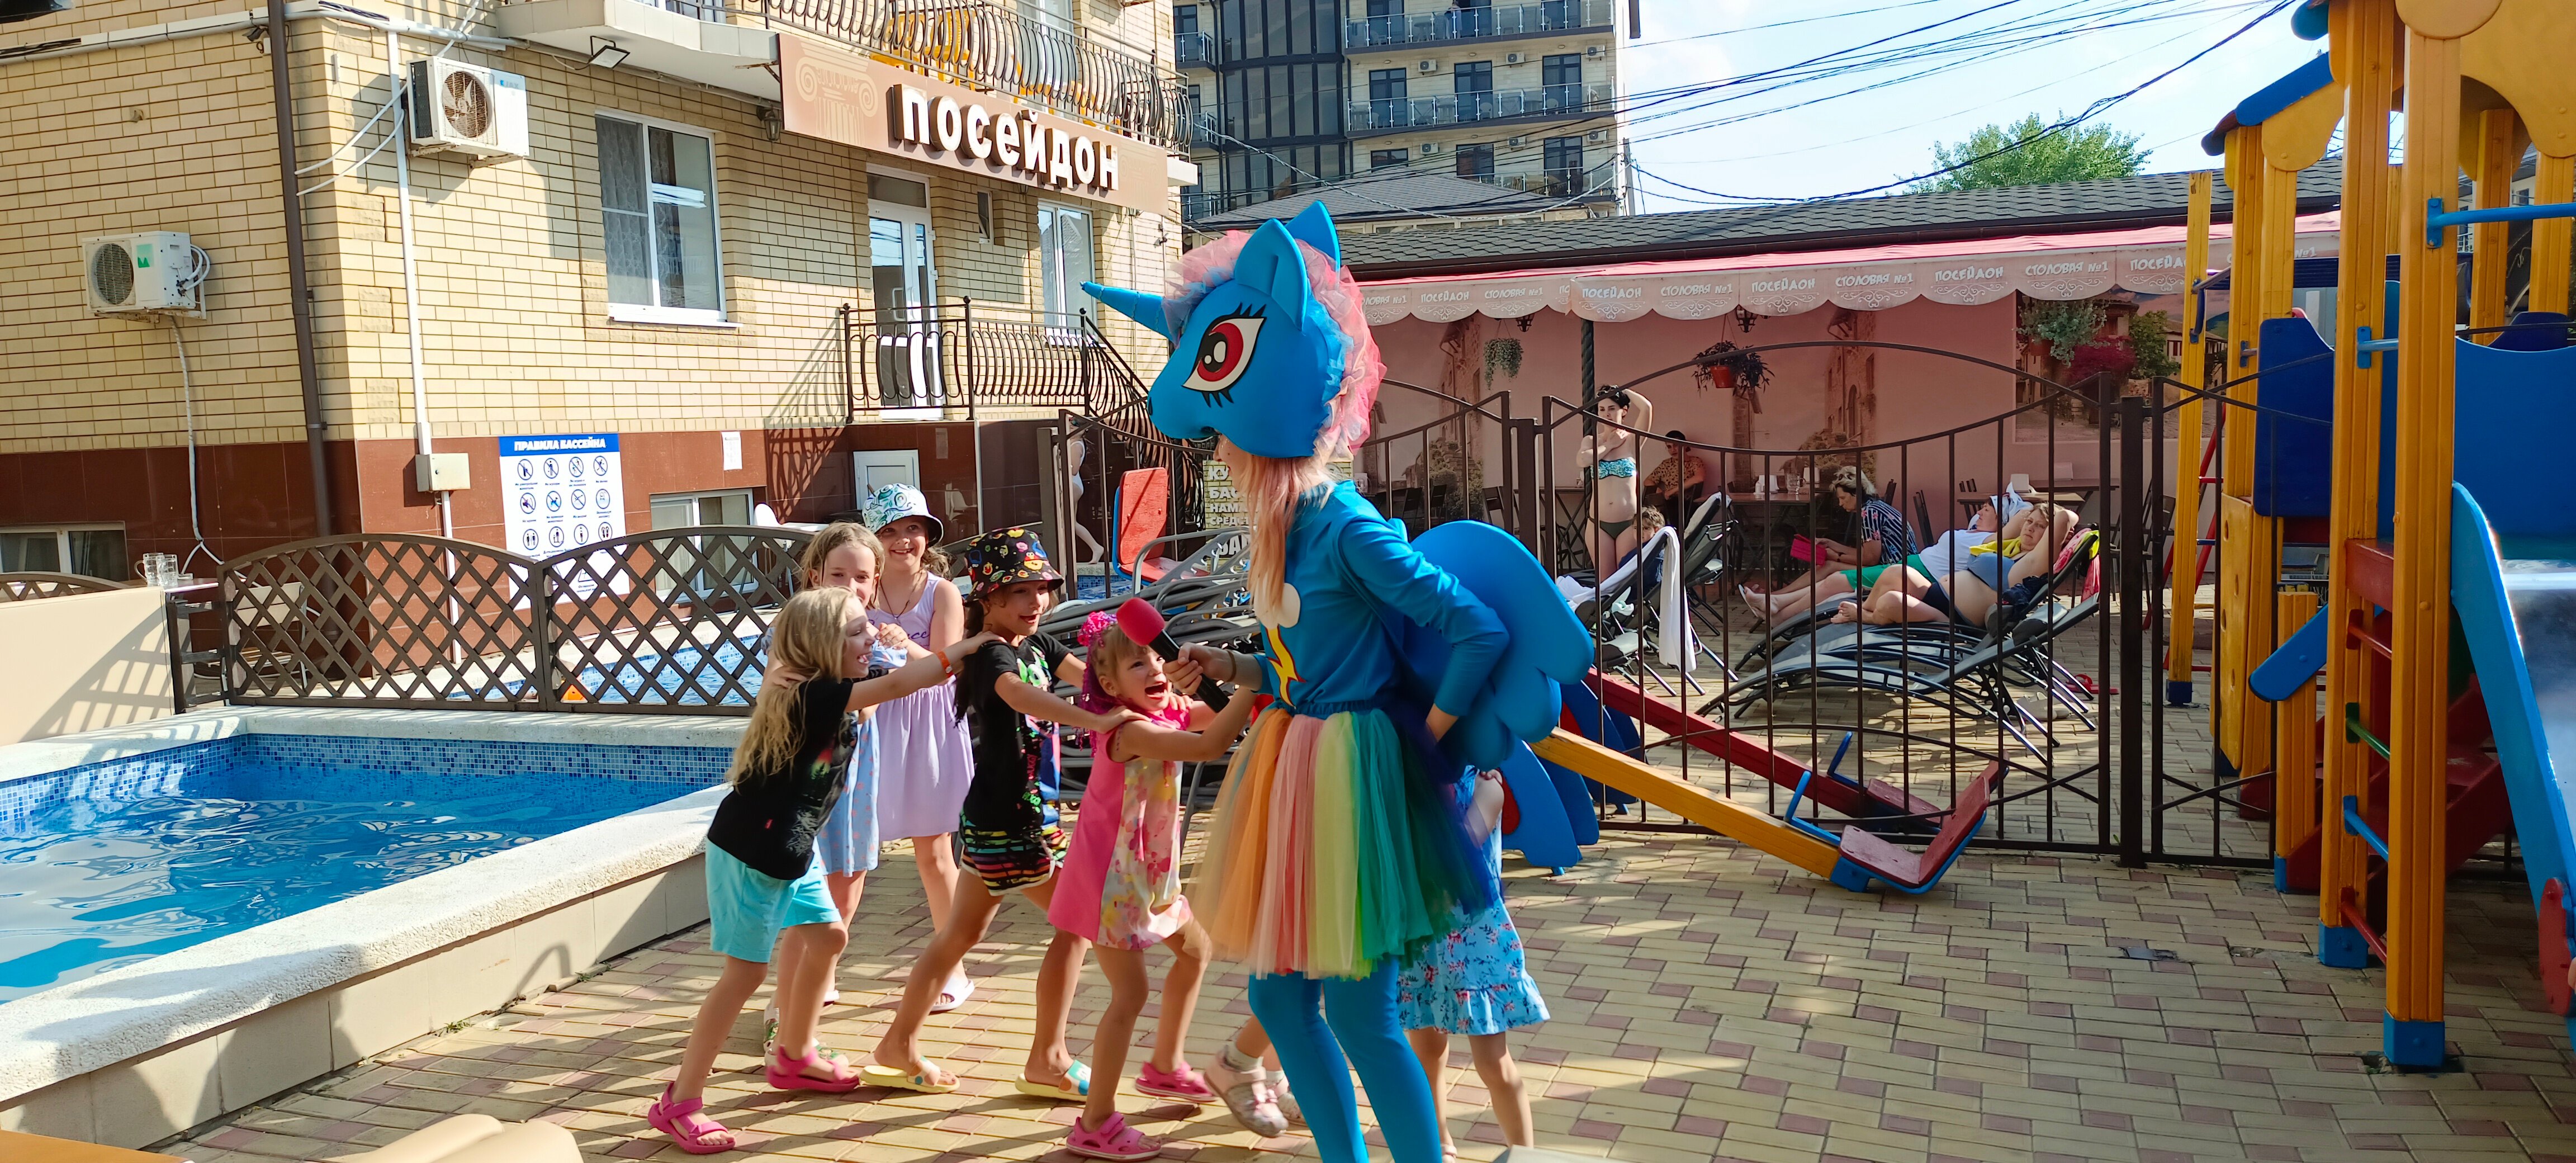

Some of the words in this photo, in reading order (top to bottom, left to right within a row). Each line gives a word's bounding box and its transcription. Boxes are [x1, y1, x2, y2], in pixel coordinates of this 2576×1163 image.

[2025, 262, 2084, 277] СТОЛОВАЯ
[2130, 254, 2186, 271] ПОСЕЙД
[1835, 273, 1891, 287] СТОЛОВАЯ
[1935, 266, 2004, 282] ПОСЕЙДОН
[1660, 283, 1711, 297] СТОЛОВАЯ
[1751, 277, 1816, 293] ПОСЕЙДОН
[1420, 290, 1470, 303] ПОСЕЙДОН
[1485, 287, 1526, 299] СТОЛОВАЯ
[1582, 286, 1642, 299] ПОСЕЙДОН
[1363, 295, 1390, 306] ЛОВАЯ
[514, 439, 560, 451] ПРАВИЛА
[560, 436, 607, 450] БАССЕЙНА
[1209, 466, 1229, 481] КУ
[1210, 486, 1239, 499] БАС
